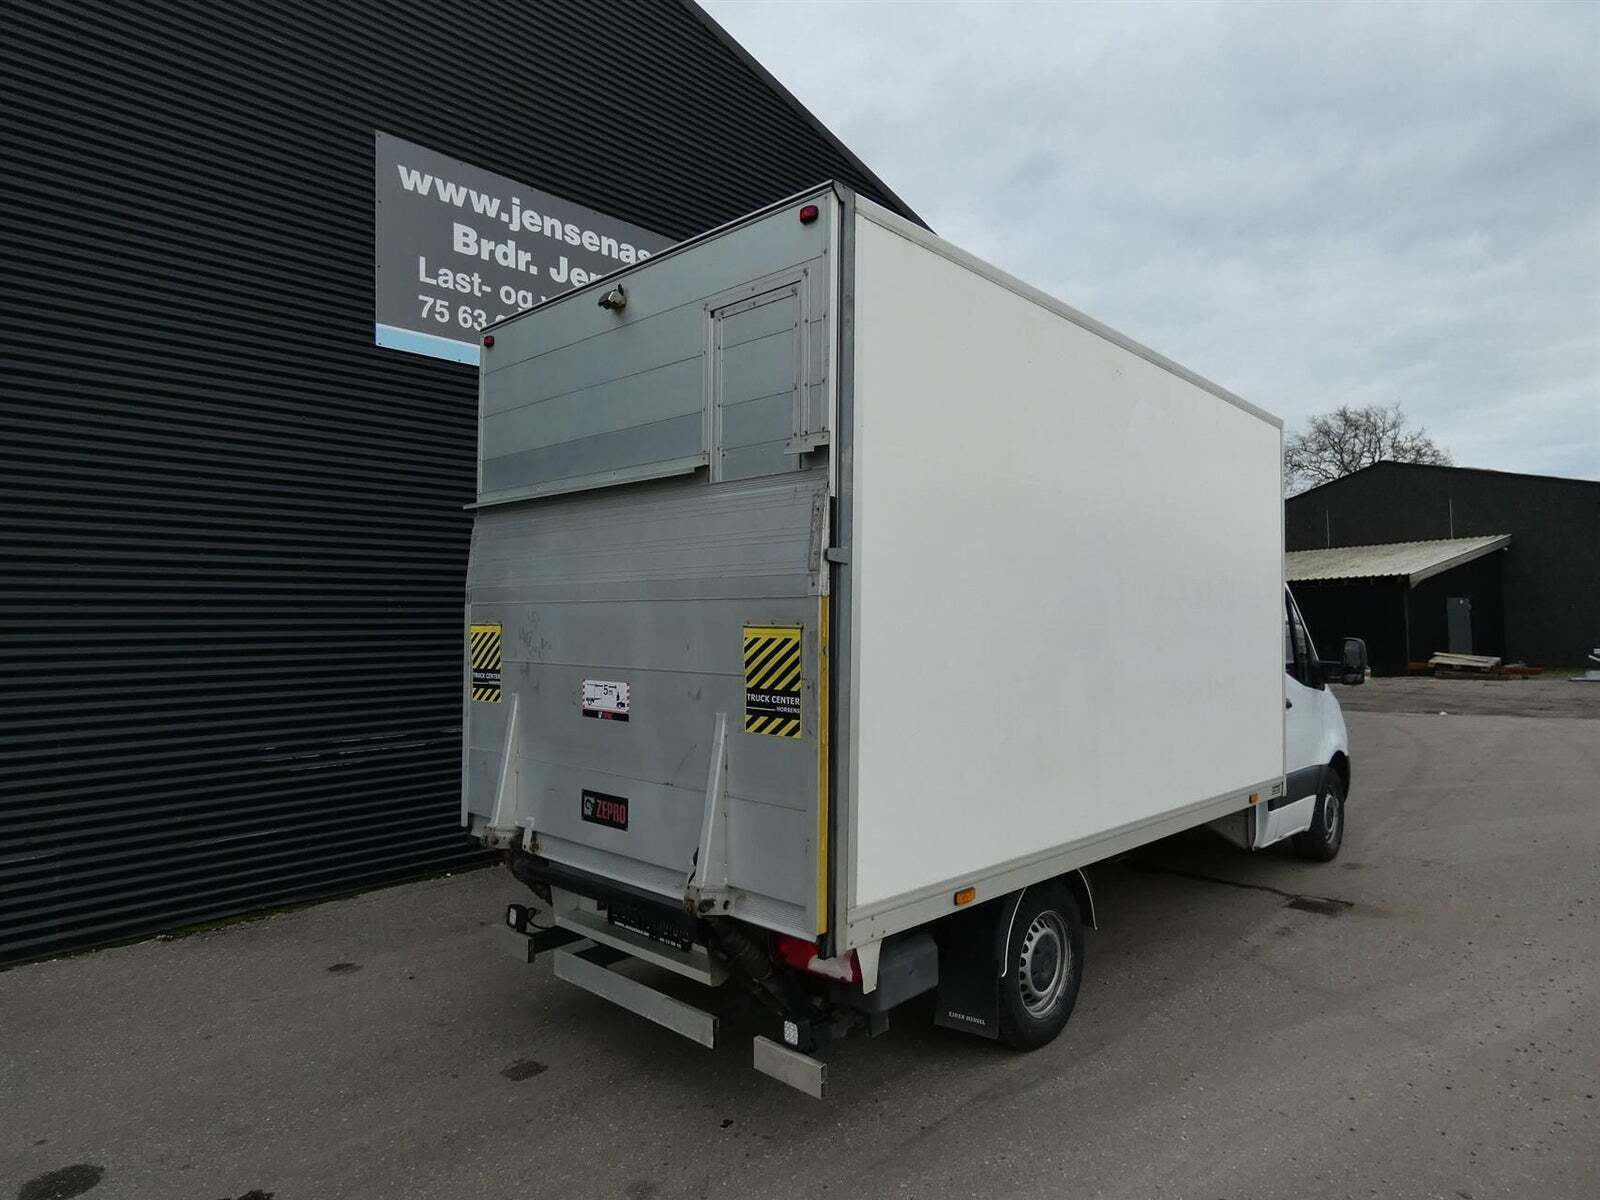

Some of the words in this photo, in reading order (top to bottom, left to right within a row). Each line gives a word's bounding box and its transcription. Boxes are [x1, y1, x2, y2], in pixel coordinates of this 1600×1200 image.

[453, 223, 538, 275] Brdr.
[419, 256, 492, 297] Last-
[500, 285, 533, 312] og
[418, 295, 450, 323] 75
[458, 305, 487, 330] 63
[747, 693, 770, 703] TRUCK
[772, 695, 800, 706] CENTER
[596, 799, 626, 824] ZEPRO
